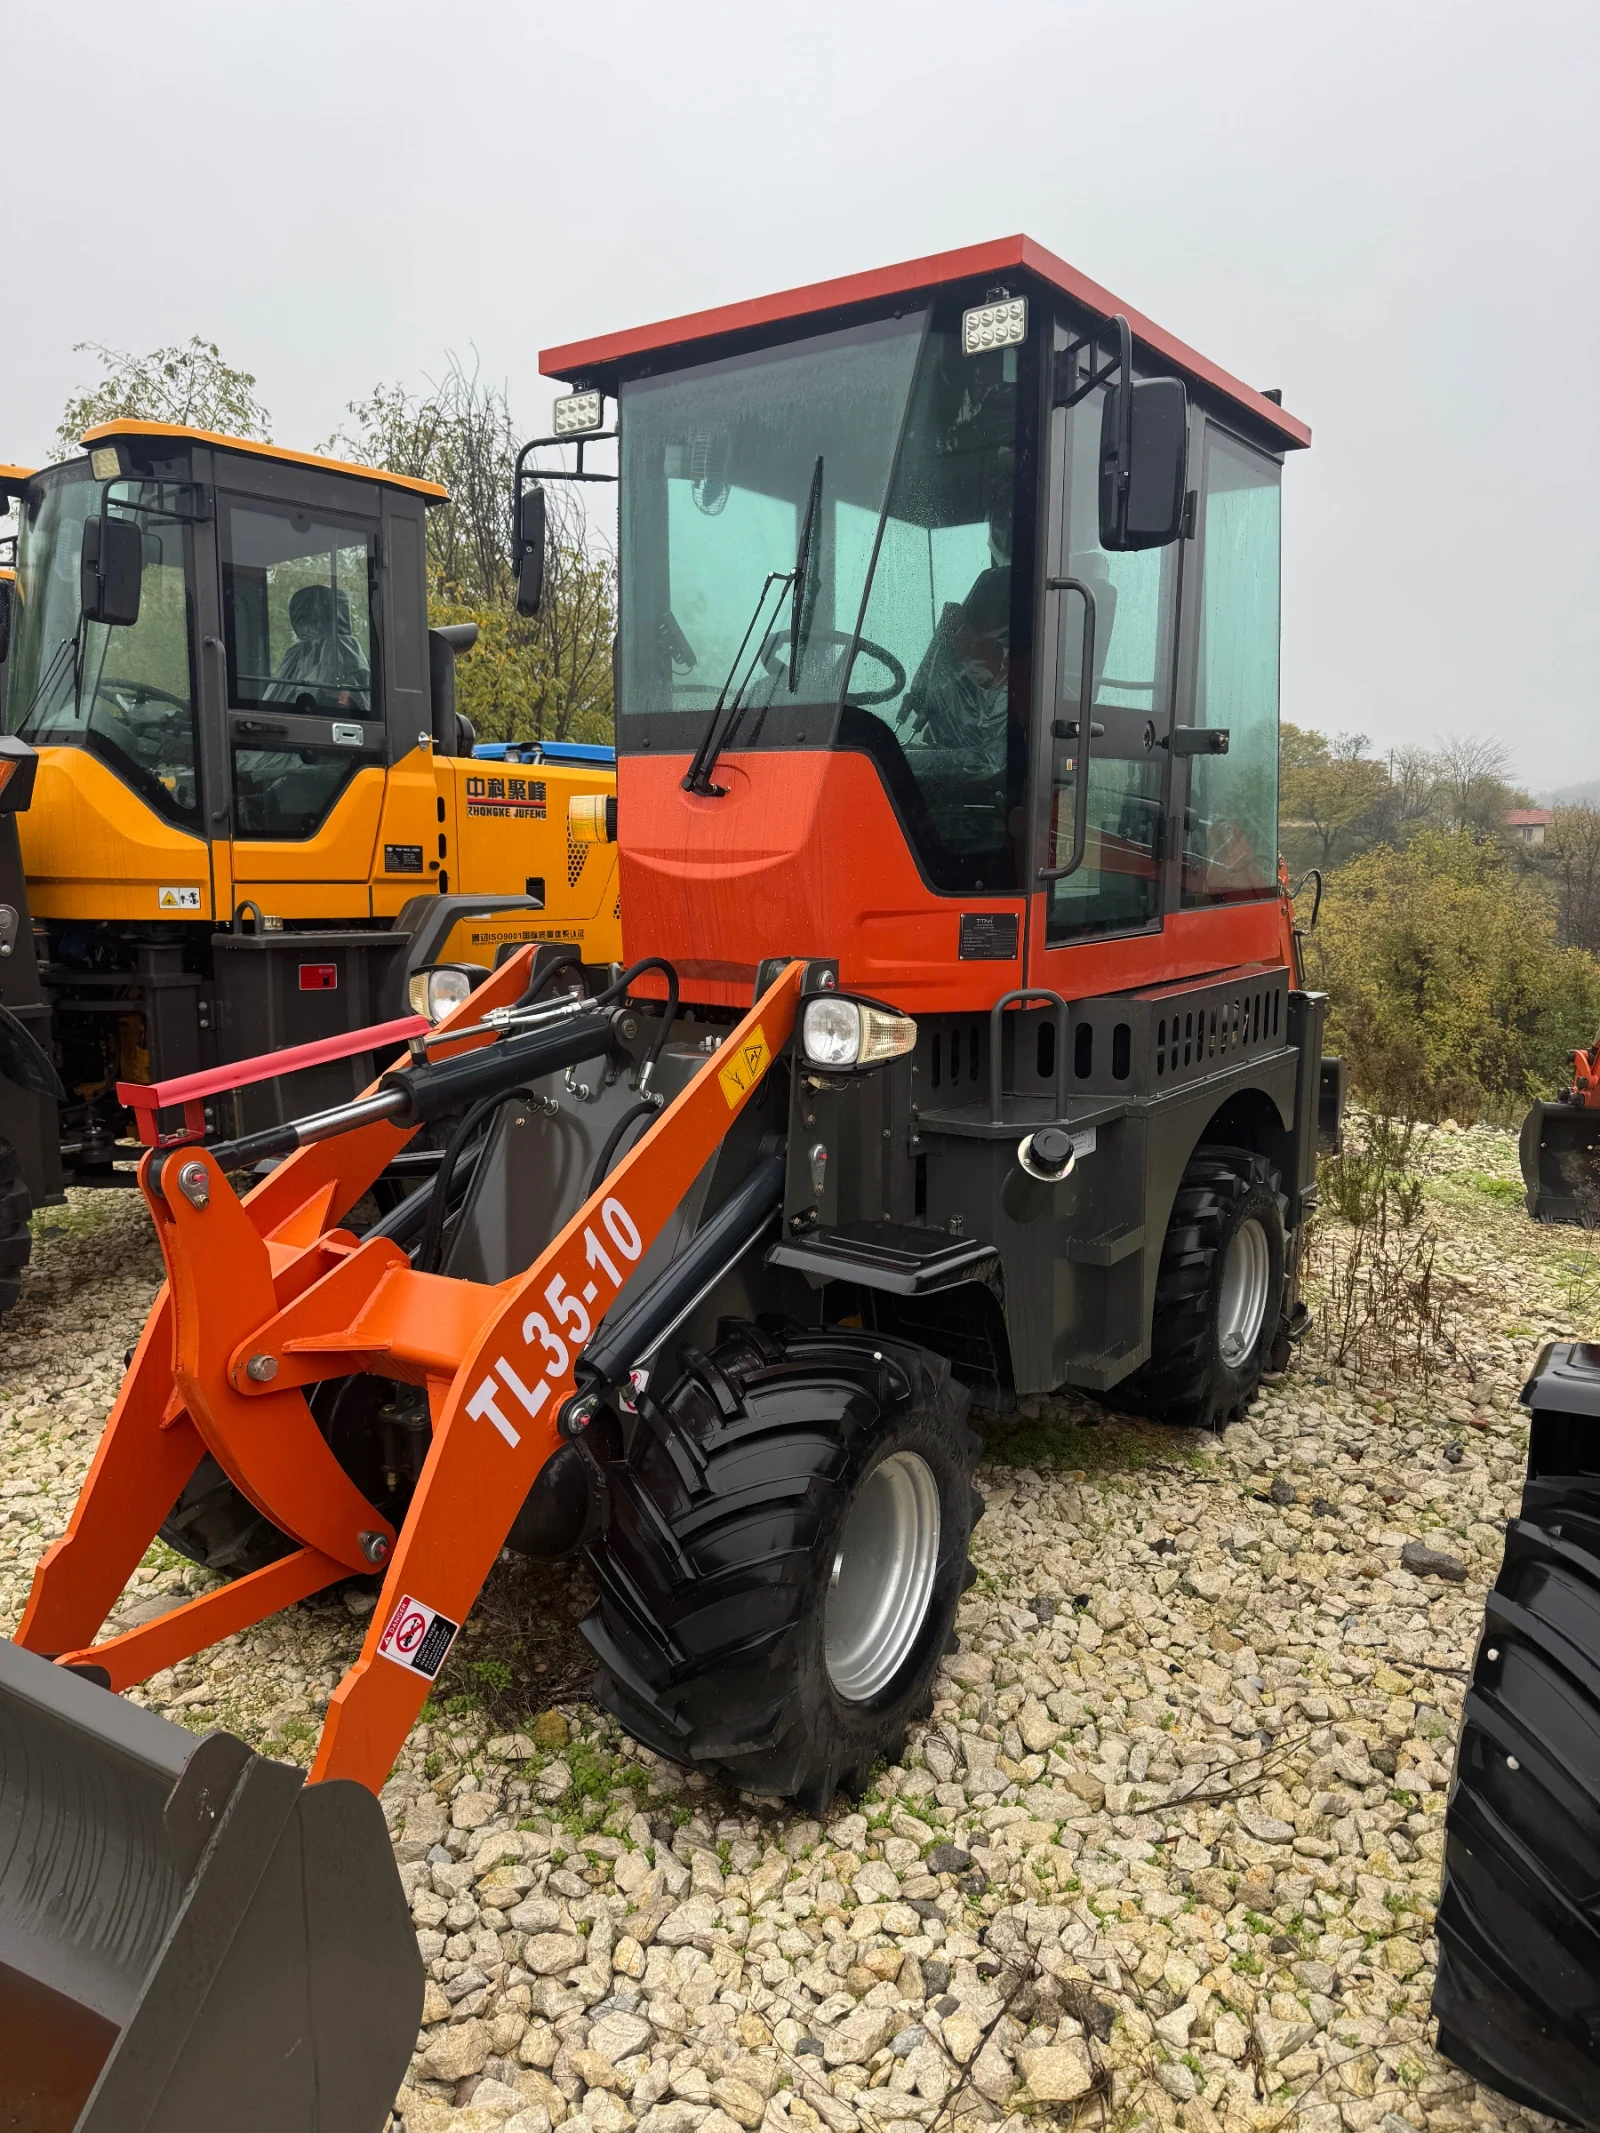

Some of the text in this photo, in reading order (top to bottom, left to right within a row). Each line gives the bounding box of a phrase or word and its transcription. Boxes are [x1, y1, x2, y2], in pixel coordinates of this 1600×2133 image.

[466, 777, 546, 801] 中科聚峰
[468, 806, 547, 818] ZHONGKE JUFENG
[465, 1198, 642, 1449] TL35-10
[389, 1603, 407, 1634] DANGER
[415, 1622, 438, 1663] CRUSH RISK
